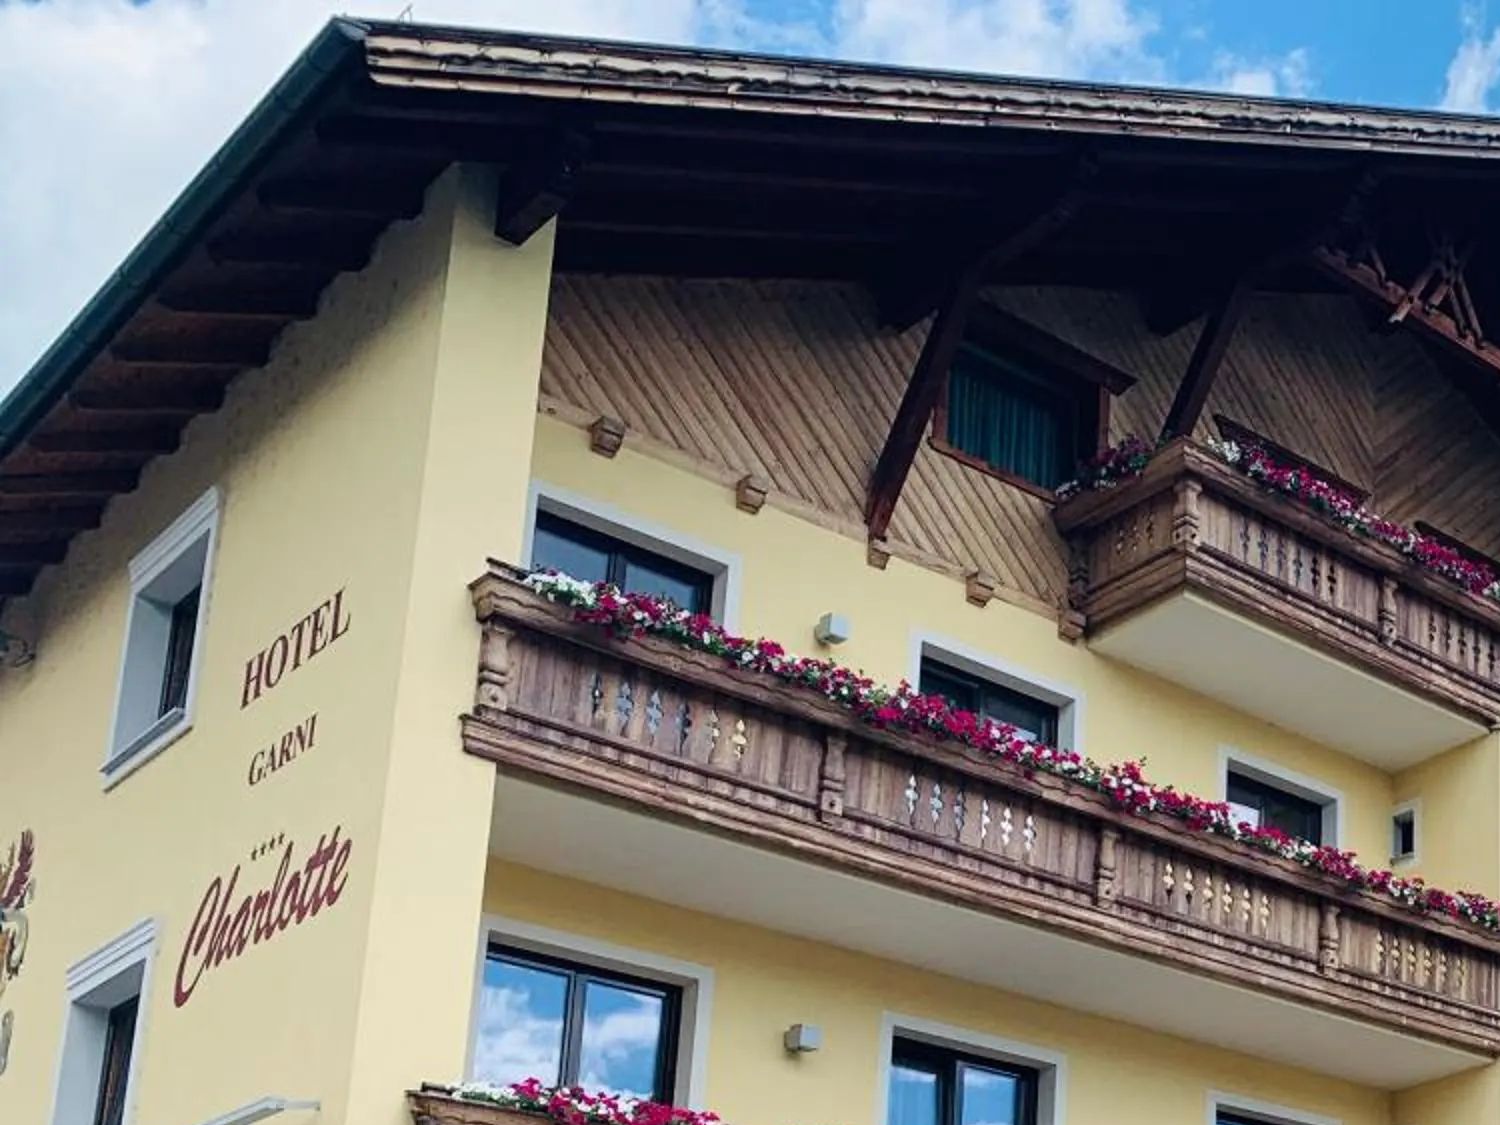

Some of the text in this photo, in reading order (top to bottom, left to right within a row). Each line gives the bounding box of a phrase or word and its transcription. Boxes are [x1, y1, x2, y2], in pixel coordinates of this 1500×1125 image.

[240, 589, 352, 710] HOTEL
[248, 713, 319, 786] GARNI
[173, 824, 353, 1008] Charlotte
